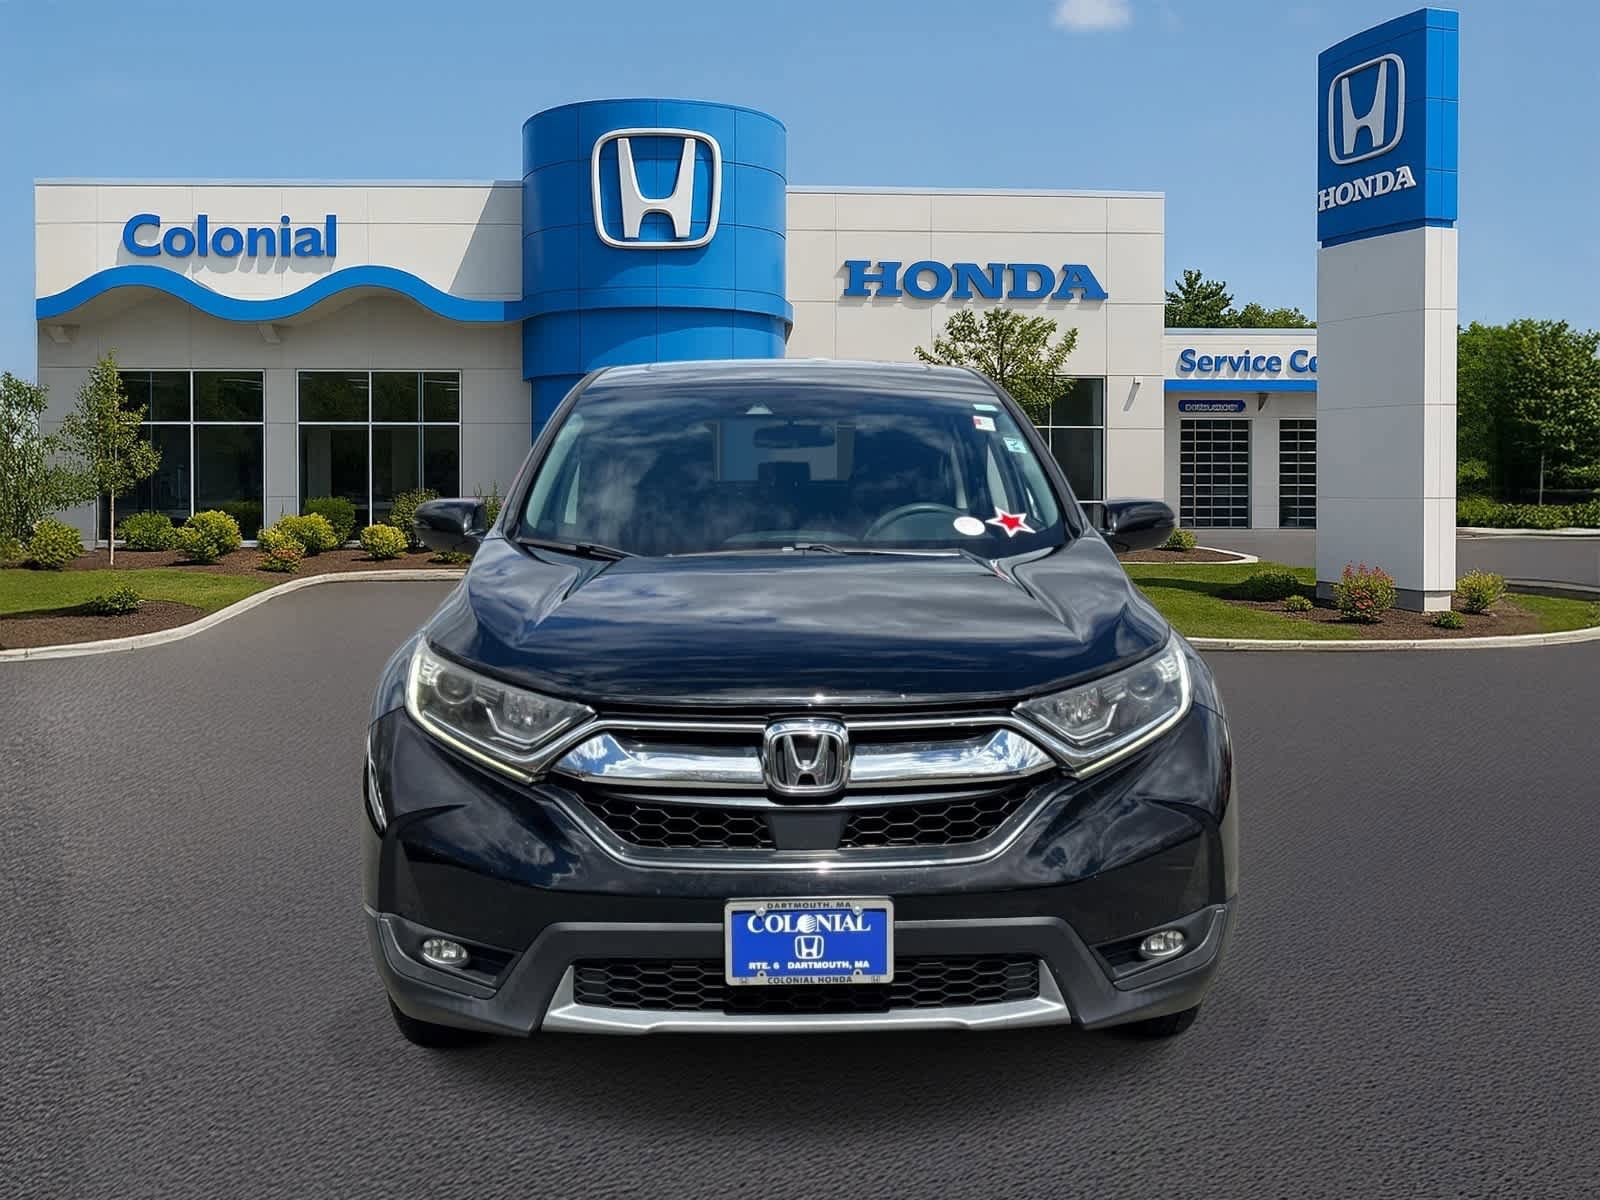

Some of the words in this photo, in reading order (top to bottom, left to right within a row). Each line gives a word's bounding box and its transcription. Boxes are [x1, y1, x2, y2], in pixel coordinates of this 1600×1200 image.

[1318, 165, 1416, 212] HONDA
[122, 213, 337, 257] Colonial
[843, 260, 1109, 300] HONDA
[1180, 348, 1281, 373] Service
[747, 913, 871, 933] COLONIAL
[748, 962, 771, 970] RTE.
[787, 961, 852, 970] DARTMOUTH,
[854, 960, 870, 968] MA
[767, 977, 815, 985] COLONIAL
[818, 976, 853, 984] HONDA
